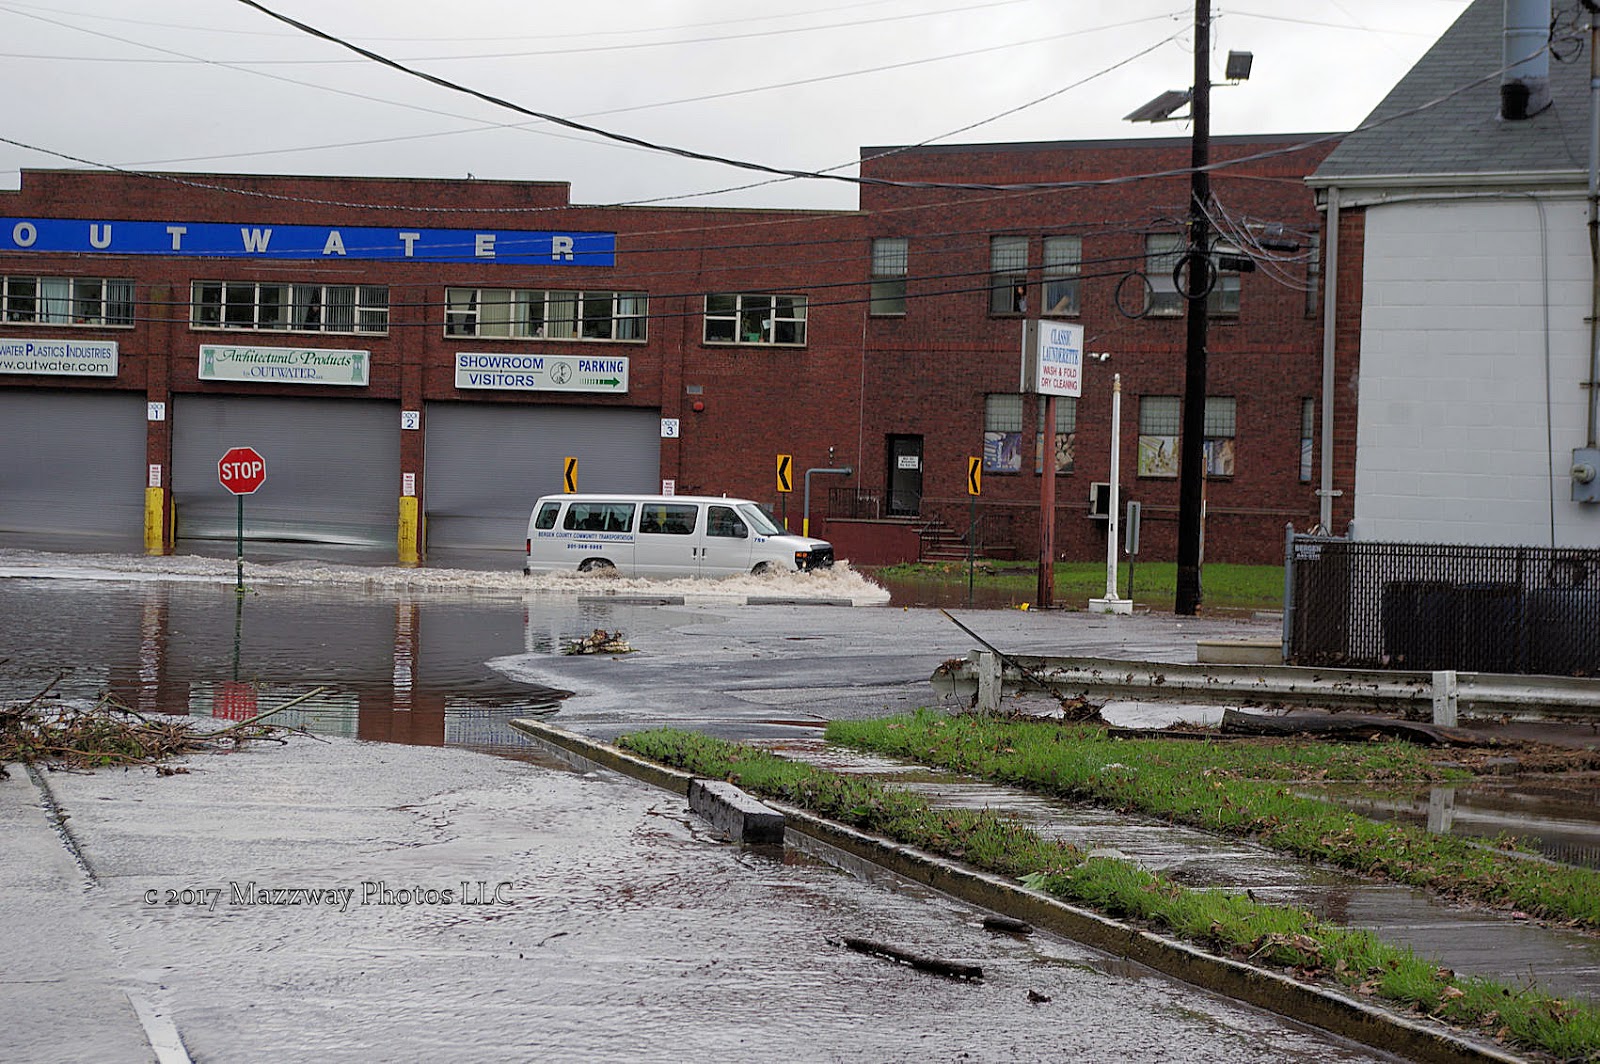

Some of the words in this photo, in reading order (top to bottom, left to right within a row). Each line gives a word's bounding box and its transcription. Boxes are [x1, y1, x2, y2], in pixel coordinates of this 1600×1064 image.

[12, 221, 575, 261] OUTWATER
[1051, 328, 1072, 346] CLASSIC
[216, 349, 298, 365] Architectural
[300, 351, 352, 367] Products
[459, 355, 544, 370] SHOWROOM
[251, 366, 317, 379] OUTWATER
[579, 360, 624, 373] PARKING
[1043, 366, 1057, 376] WASH
[1064, 368, 1077, 378] FOLD
[469, 373, 535, 387] VISITORS
[1041, 377, 1051, 387] DRY
[1053, 378, 1077, 390] CLEANING
[154, 409, 159, 419] 1
[406, 418, 414, 428] 2
[666, 426, 674, 436] 3
[222, 461, 262, 480] STOP
